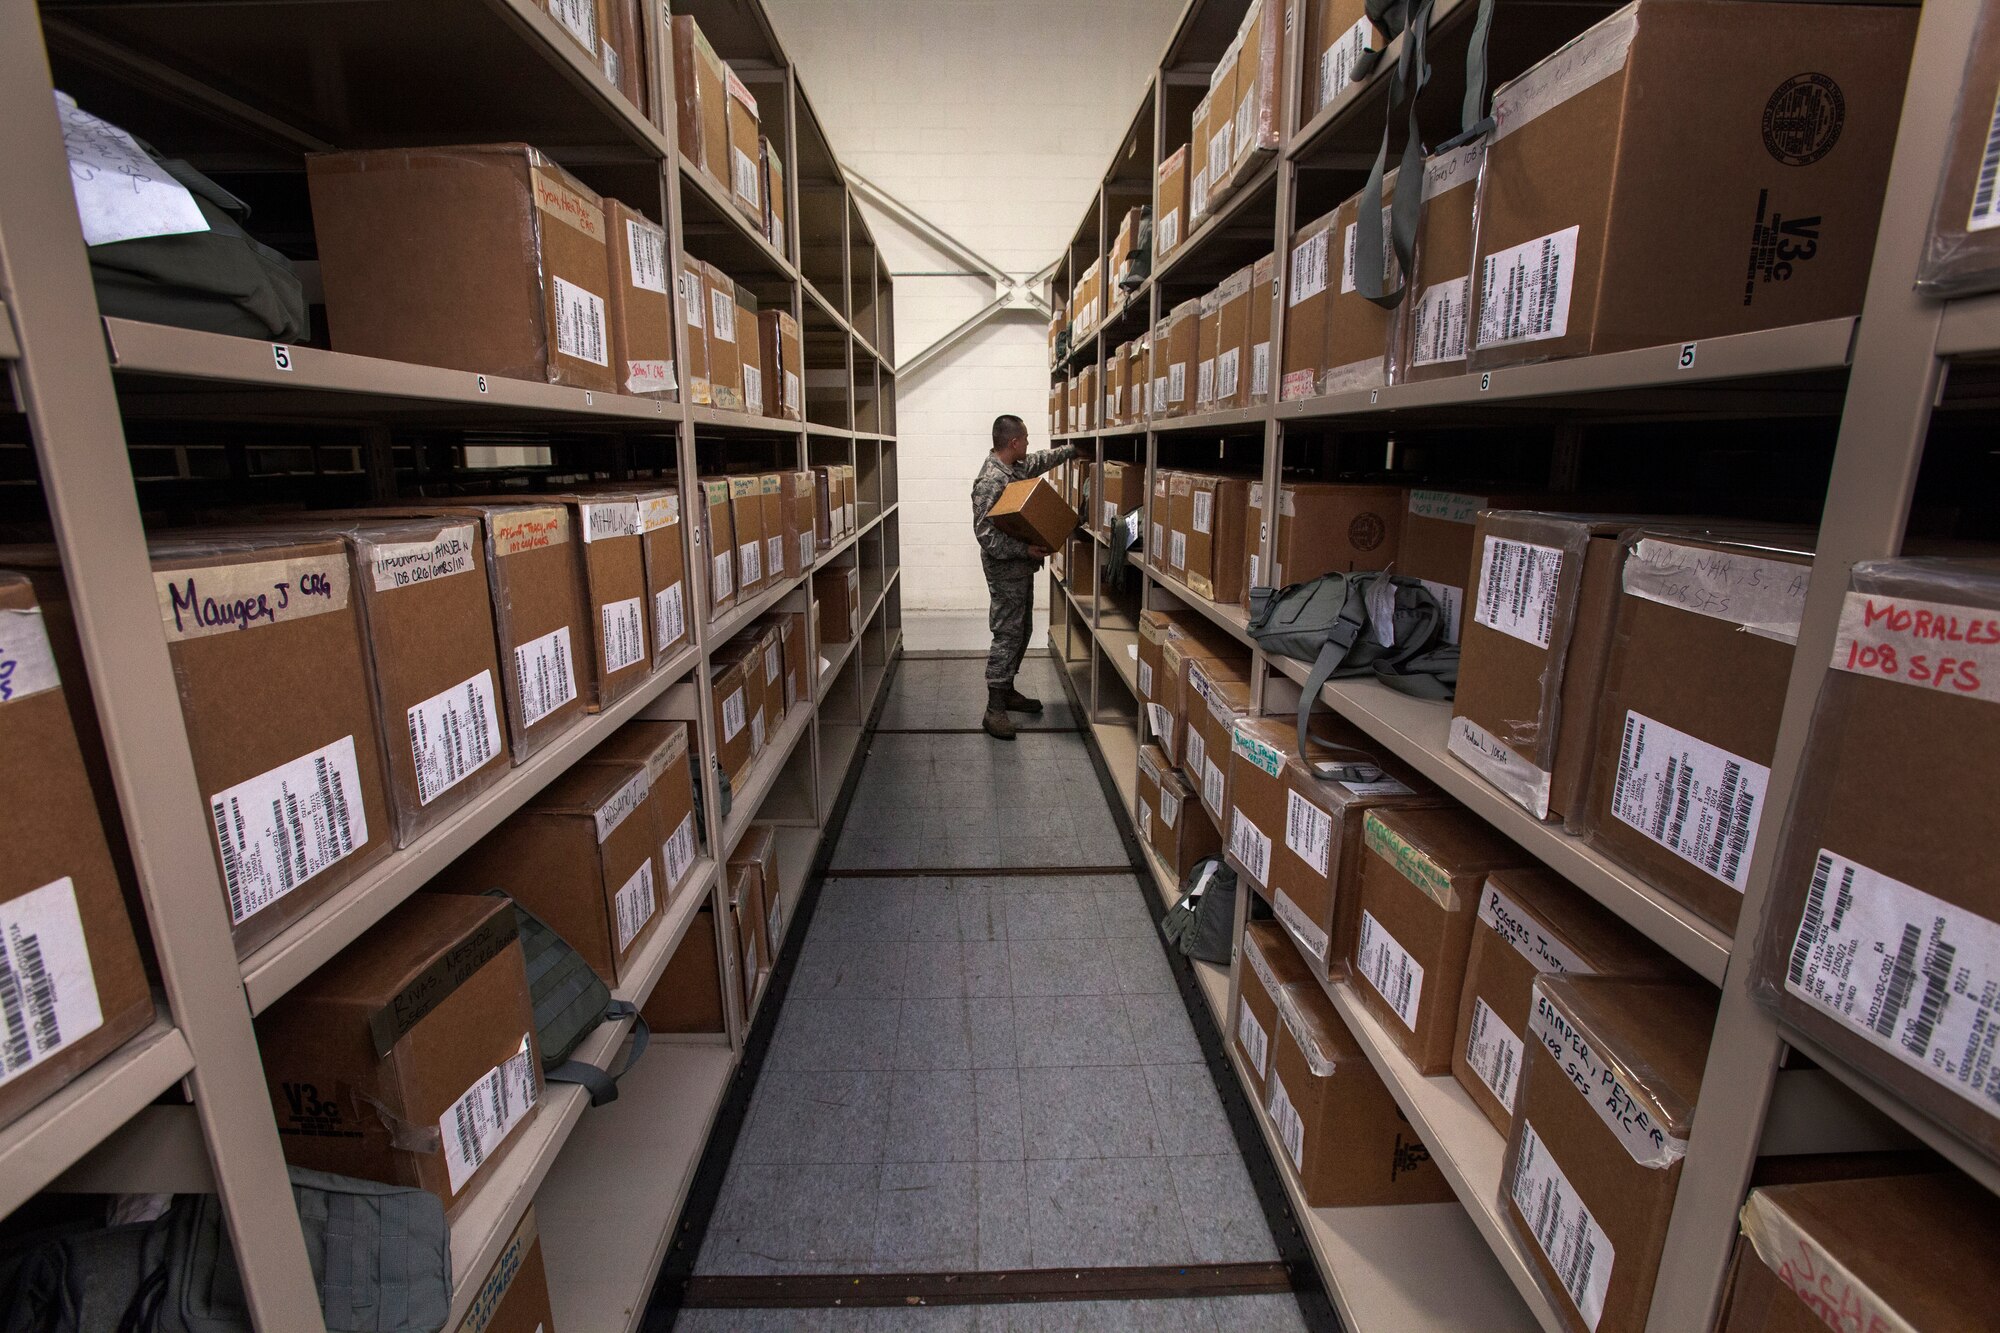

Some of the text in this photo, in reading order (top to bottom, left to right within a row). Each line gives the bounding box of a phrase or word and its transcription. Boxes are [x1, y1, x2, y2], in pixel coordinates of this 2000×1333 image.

[274, 346, 289, 368] 5
[1681, 345, 1695, 367] 5
[478, 376, 487, 392] 6
[1372, 390, 1378, 402] 7
[1481, 374, 1489, 390] 6
[586, 391, 592, 404] 7
[274, 582, 290, 609] J
[299, 572, 332, 599] CRG
[394, 572, 410, 587] 108
[1657, 579, 1731, 613] 108 SFS
[1864, 599, 2000, 645] MORALES
[1846, 639, 1981, 692] 108 SFS
[1654, 771, 1659, 780] EA
[265, 826, 271, 837] EA
[1631, 813, 1635, 823] PN
[315, 829, 325, 867] ASSEMBLED
[1692, 822, 1704, 861] ASSEMBLED
[1698, 831, 1709, 864] INSP/TEST
[249, 889, 257, 909] CAGE
[257, 894, 263, 905] PN
[1821, 942, 1835, 972] 1LEW5
[1830, 942, 1847, 978] 71050/2
[1873, 939, 1885, 954] EA
[1846, 983, 1857, 1002] MED
[1953, 965, 1971, 995] 02/11
[1979, 978, 1998, 1009] 02/11
[1904, 1016, 1917, 1034] NO
[1970, 1006, 1989, 1034] DATE
[1542, 1032, 1561, 1060] 108
[1565, 1062, 1591, 1096] SFS
[1969, 1020, 2000, 1091] NSP/TEST DATE
[282, 1082, 339, 1118] V3c
[1601, 1069, 1664, 1149] PETER
